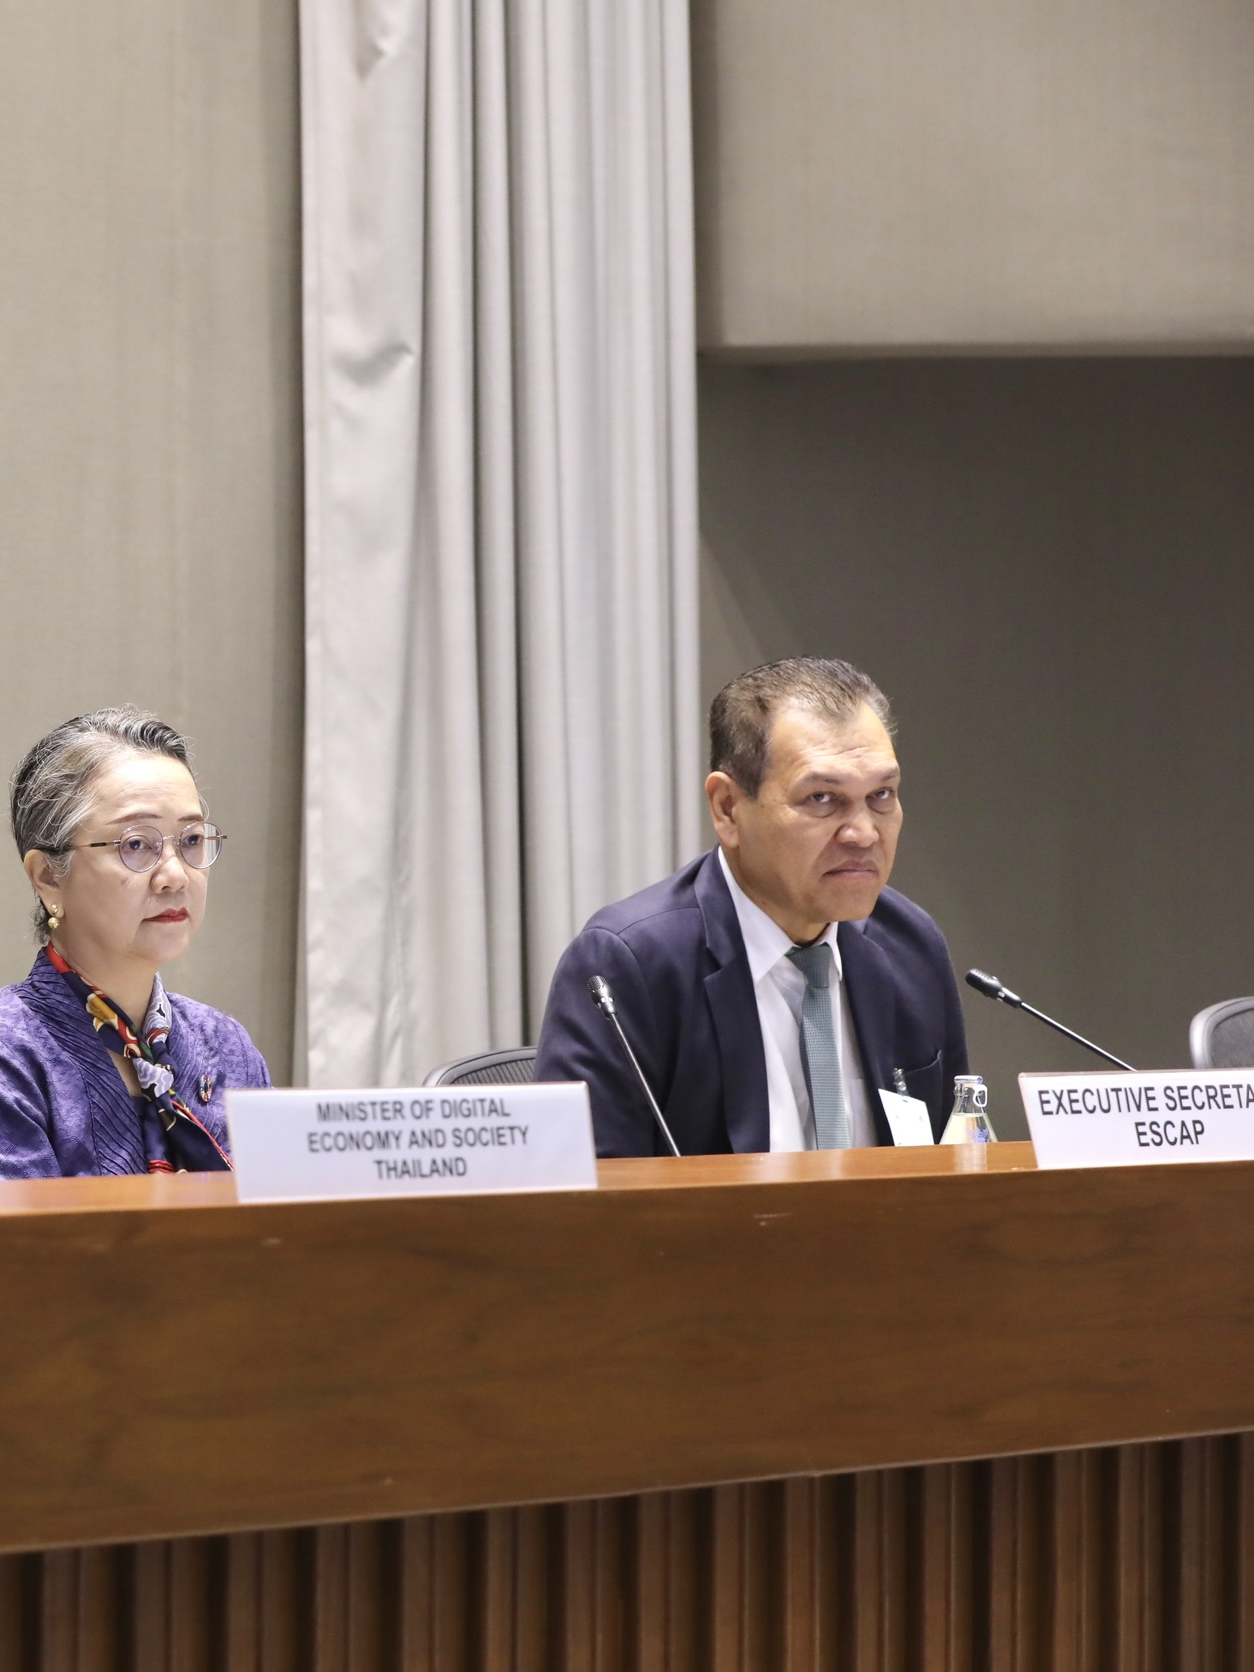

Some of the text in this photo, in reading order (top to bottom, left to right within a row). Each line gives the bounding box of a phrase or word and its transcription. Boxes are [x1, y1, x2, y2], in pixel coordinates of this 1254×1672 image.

[316, 1097, 512, 1122] MINISTER OF DIGITAL
[1037, 1086, 1159, 1115] EXECUTIVE
[308, 1126, 530, 1153] ECONOMY AND SOCIETY
[1135, 1119, 1205, 1147] ESCAP
[374, 1157, 467, 1180] THAILAND
